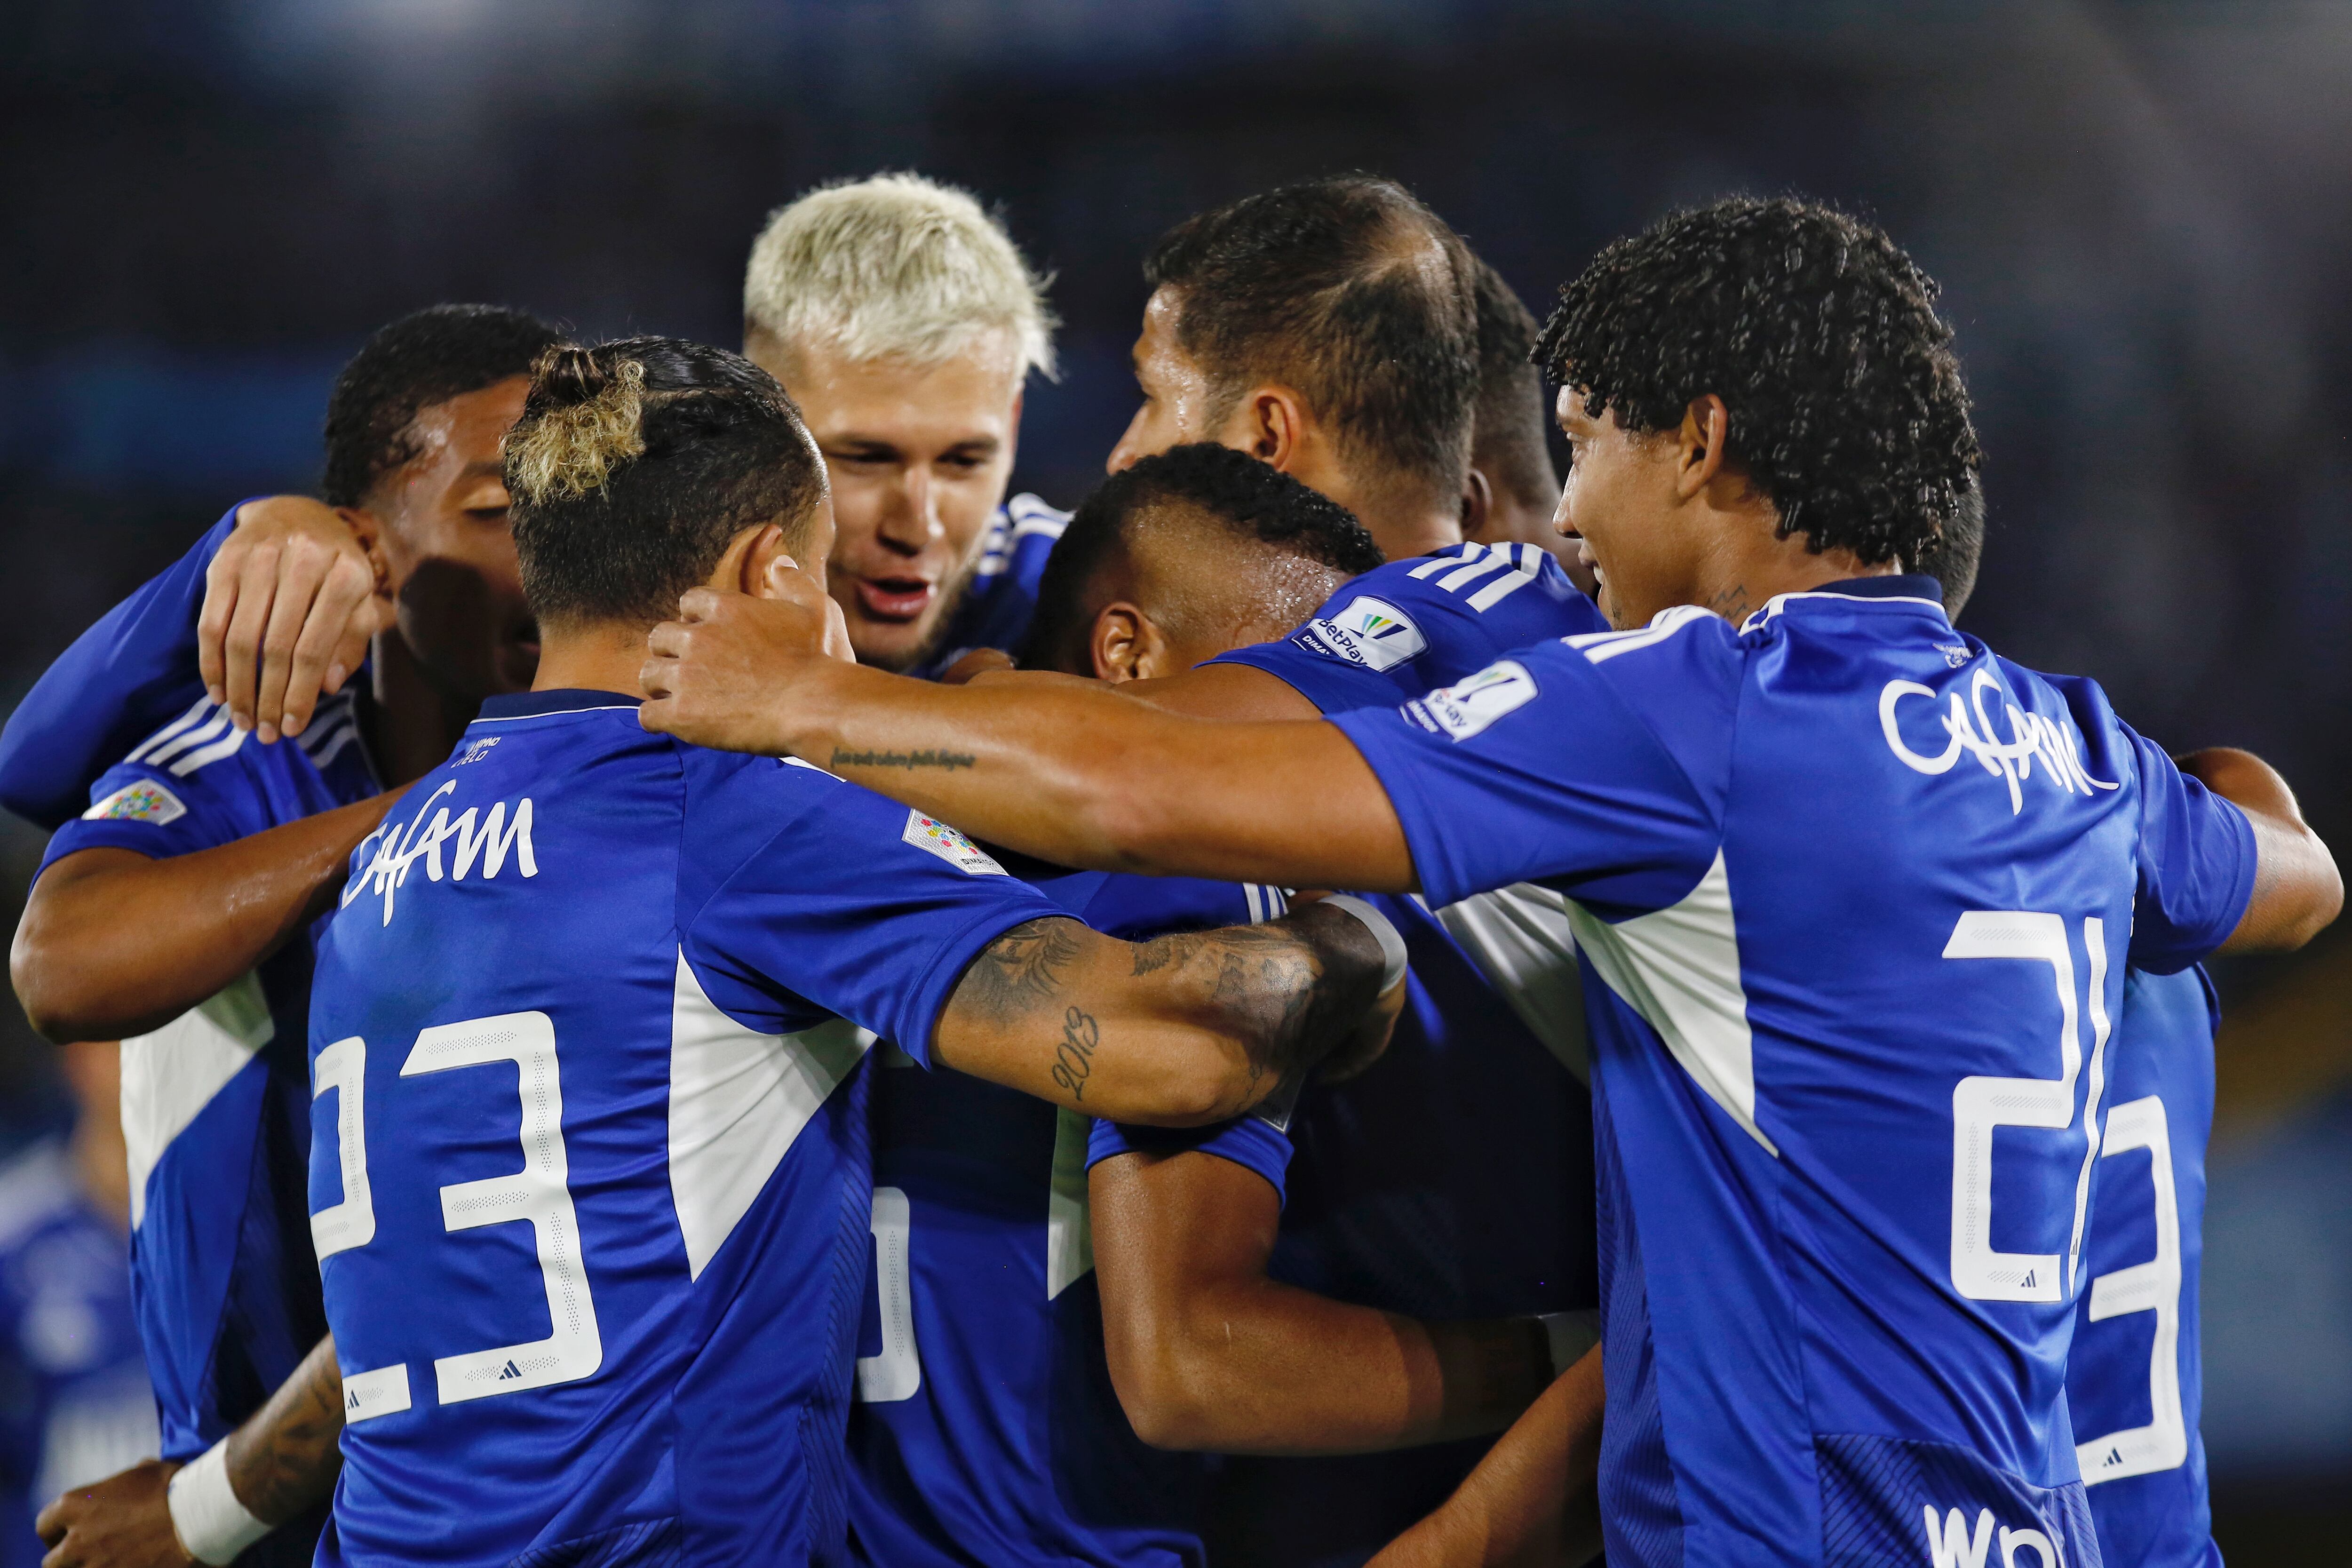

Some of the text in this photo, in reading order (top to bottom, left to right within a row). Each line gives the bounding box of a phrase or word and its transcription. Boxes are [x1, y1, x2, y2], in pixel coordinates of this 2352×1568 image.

[1302, 635, 1330, 655] DIMA
[309, 1011, 603, 1425] 23
[1942, 911, 2111, 1302] 21
